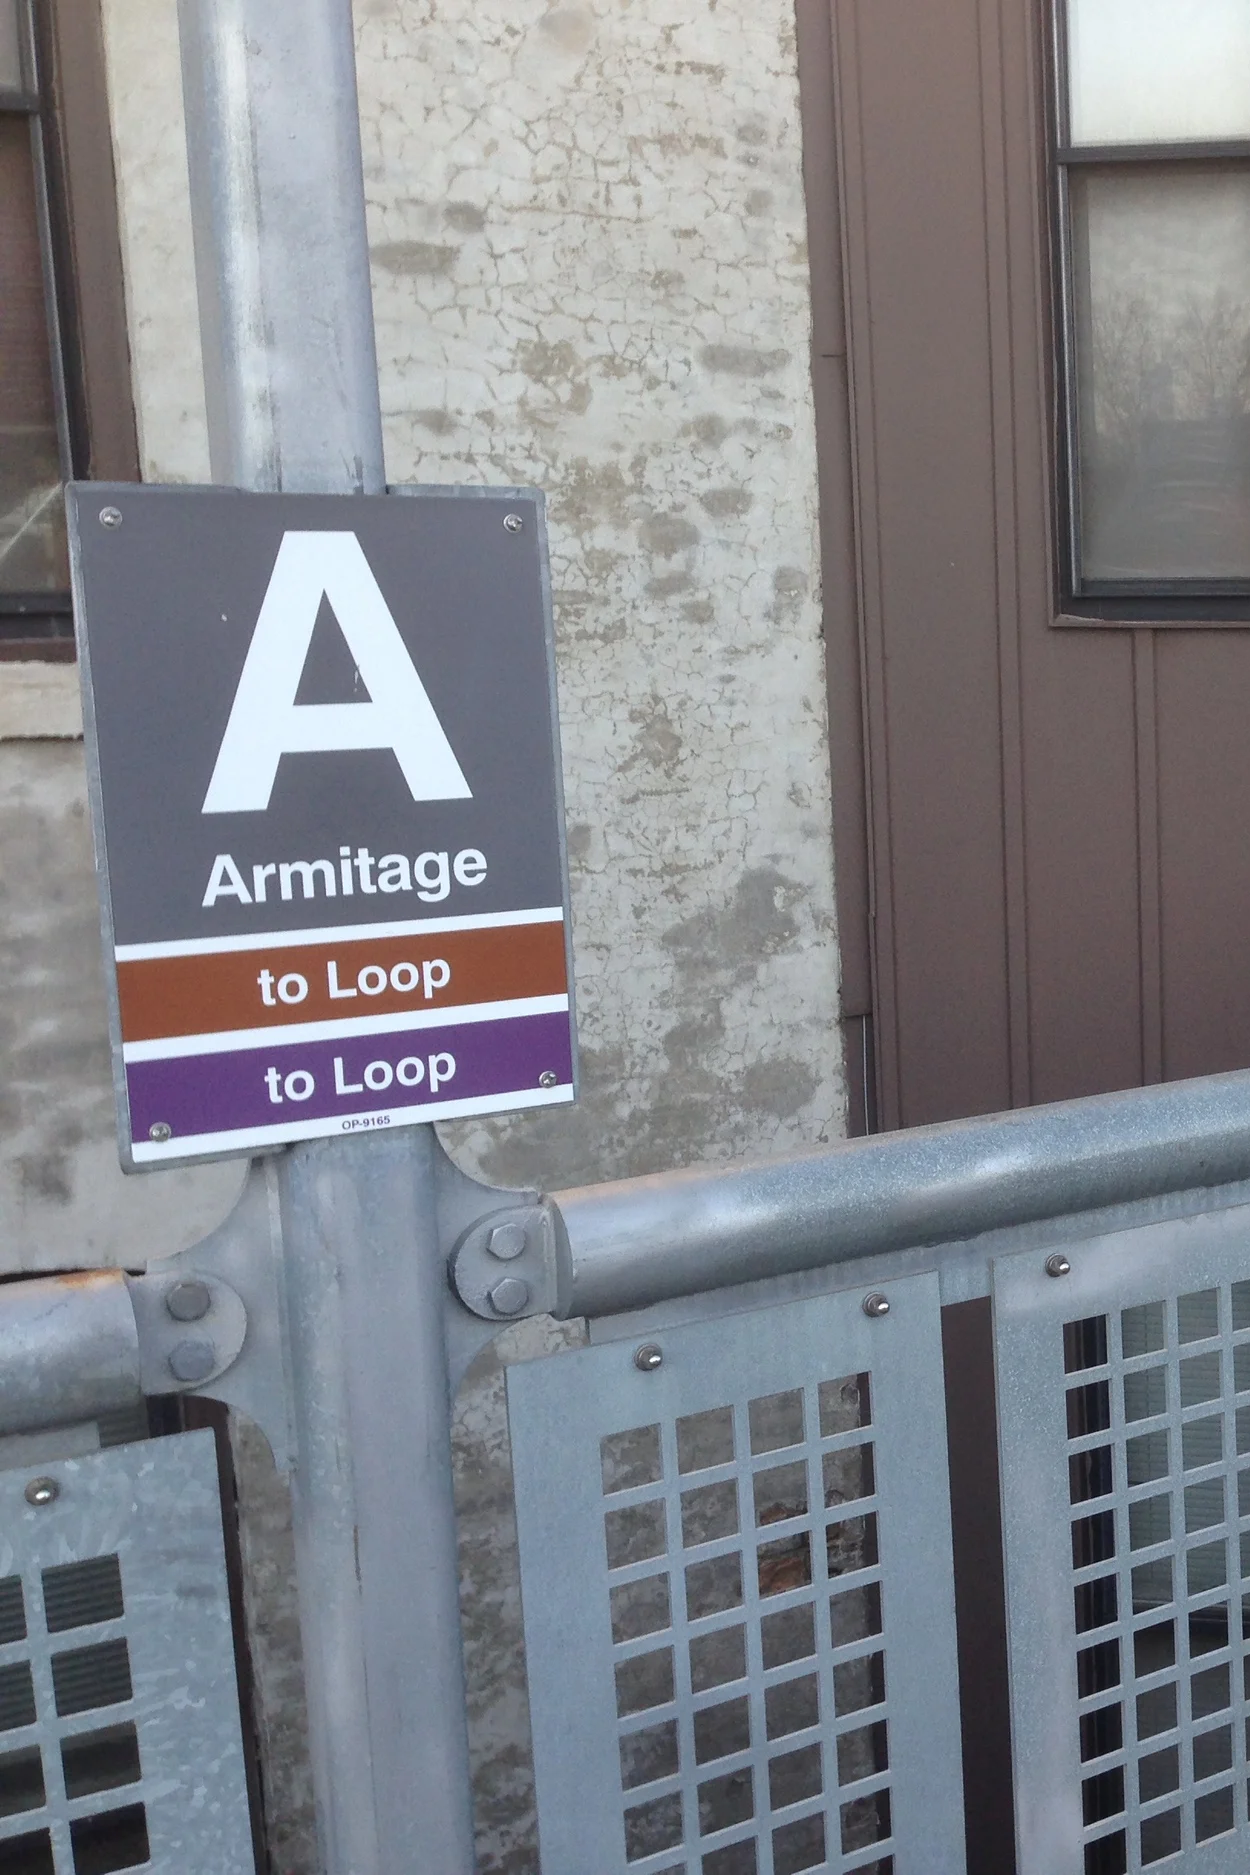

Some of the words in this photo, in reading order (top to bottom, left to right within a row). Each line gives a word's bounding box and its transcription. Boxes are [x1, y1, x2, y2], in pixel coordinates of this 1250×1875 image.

[200, 530, 474, 814] A
[202, 846, 488, 908] Armitage
[257, 969, 308, 1006] to
[327, 958, 451, 1000] Loop
[264, 1066, 315, 1104] to
[334, 1051, 456, 1096] Loop
[341, 1116, 391, 1131] OP-9165
